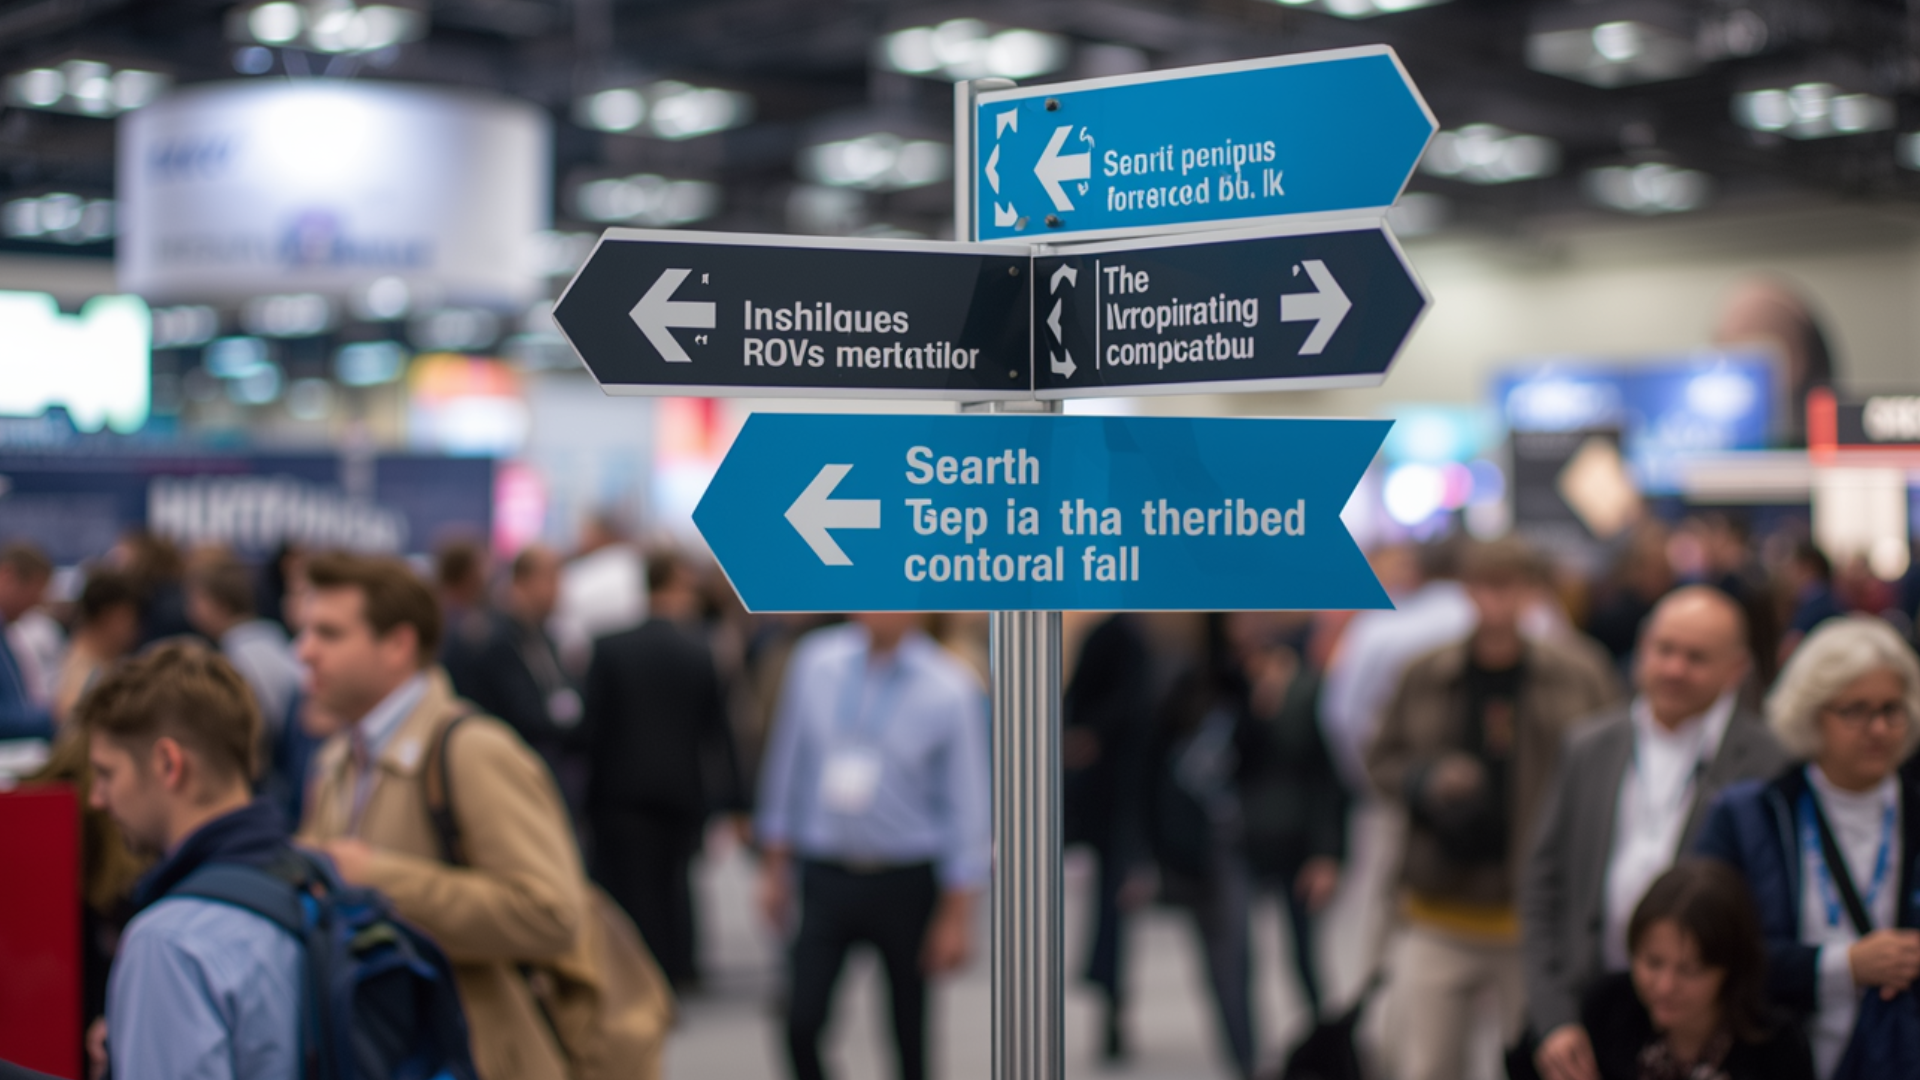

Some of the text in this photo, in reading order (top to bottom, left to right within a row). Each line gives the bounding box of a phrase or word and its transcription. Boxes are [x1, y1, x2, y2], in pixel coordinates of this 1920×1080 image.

[1103, 264, 1150, 295] The
[743, 337, 825, 368] ROVs
[905, 445, 1040, 485] Searth
[1006, 497, 1039, 536] ia
[1059, 498, 1122, 536] tha
[1141, 498, 1306, 536] theribed
[904, 545, 1140, 582] contoral fall
